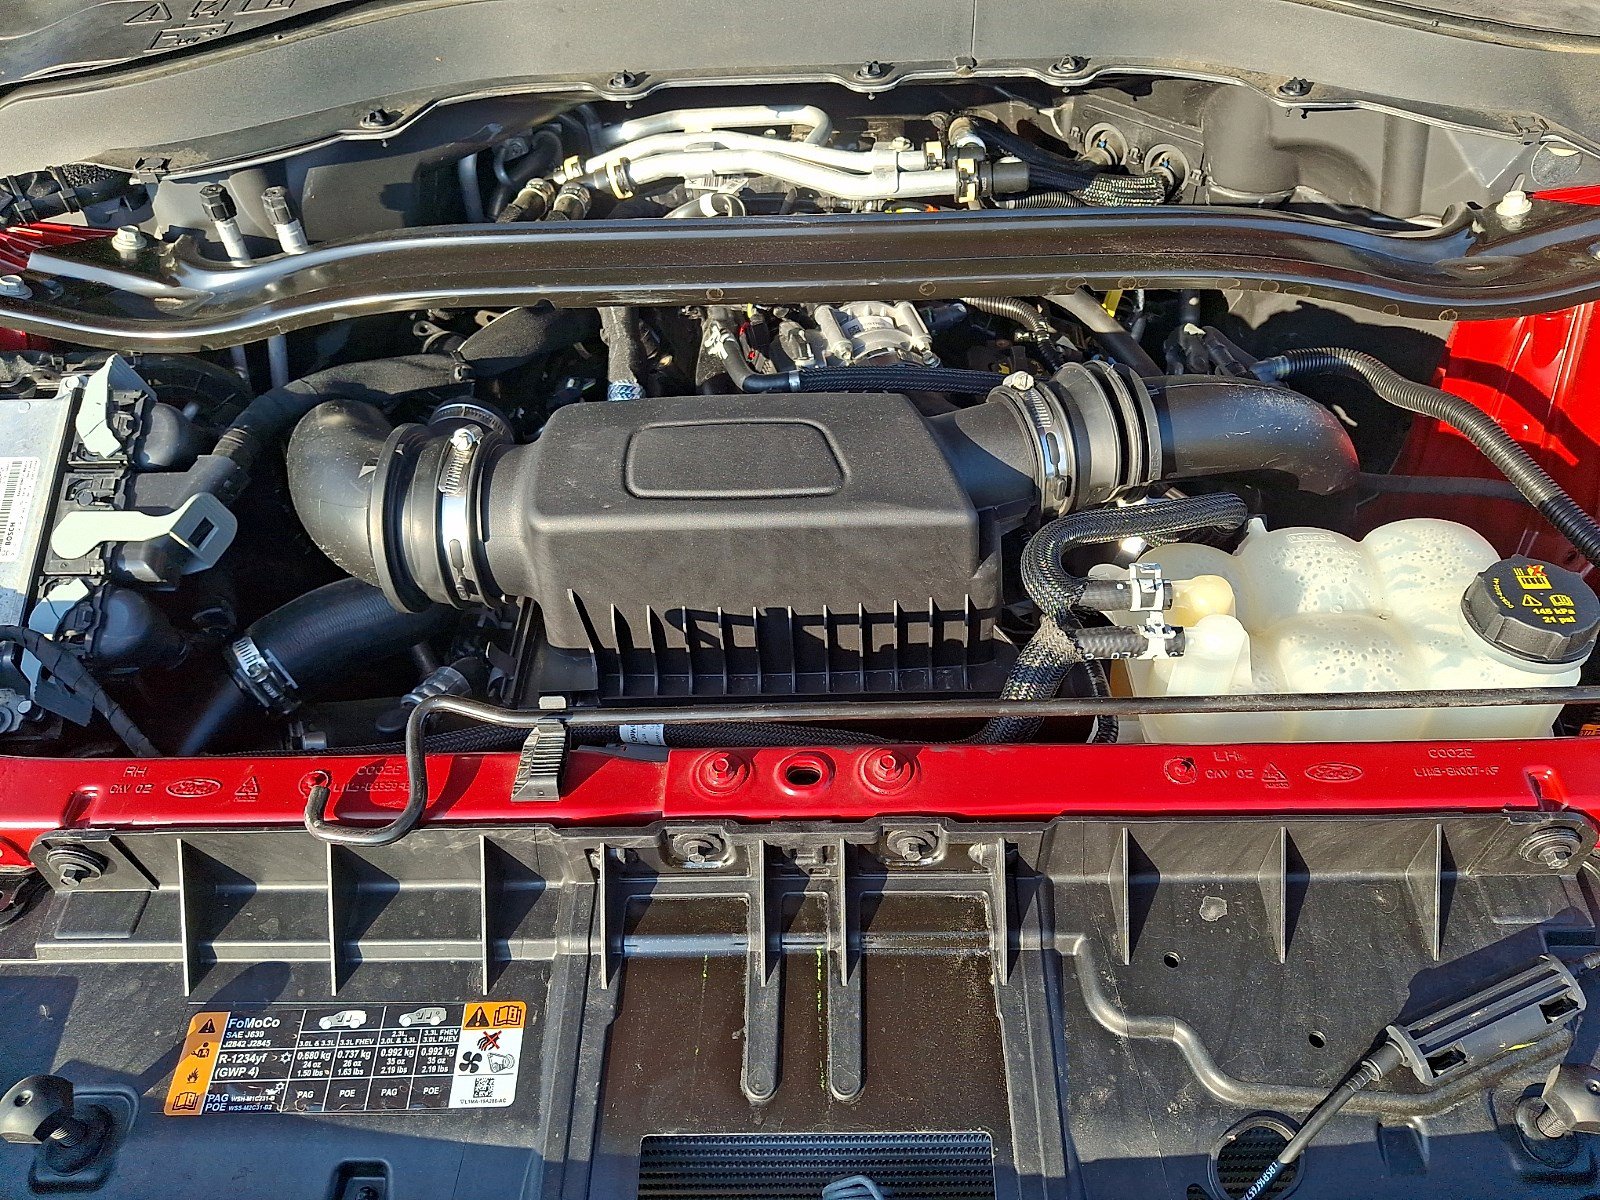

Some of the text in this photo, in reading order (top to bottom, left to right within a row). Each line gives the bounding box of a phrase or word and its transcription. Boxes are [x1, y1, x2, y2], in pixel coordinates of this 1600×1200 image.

[4, 521, 16, 546] BOSCH
[1542, 615, 1557, 623] 21
[123, 765, 147, 777] RH
[228, 1016, 280, 1028] FoMoCo
[226, 1030, 264, 1039] SAE J639
[223, 1039, 271, 1048] J2842 J2845
[297, 1050, 331, 1061] 0.680 kg
[337, 1049, 371, 1060] 0.737 kg
[380, 1047, 415, 1058] 0.992 kg
[421, 1046, 455, 1057] 0.992 kg
[219, 1052, 268, 1065] R-1234yf
[386, 1057, 396, 1065] 35
[302, 1060, 312, 1069] 24
[437, 1065, 449, 1073] lbs
[215, 1066, 260, 1079] (GWP 4)
[297, 1069, 323, 1077] 1.50 lbs
[337, 1068, 352, 1076] 1.63
[380, 1066, 407, 1074] 2.19 lbs
[297, 1090, 314, 1098] PAG
[339, 1089, 356, 1097] POE
[381, 1088, 398, 1096] PAG
[423, 1087, 440, 1095] POE
[207, 1093, 229, 1102] PAG
[205, 1102, 227, 1111] POE
